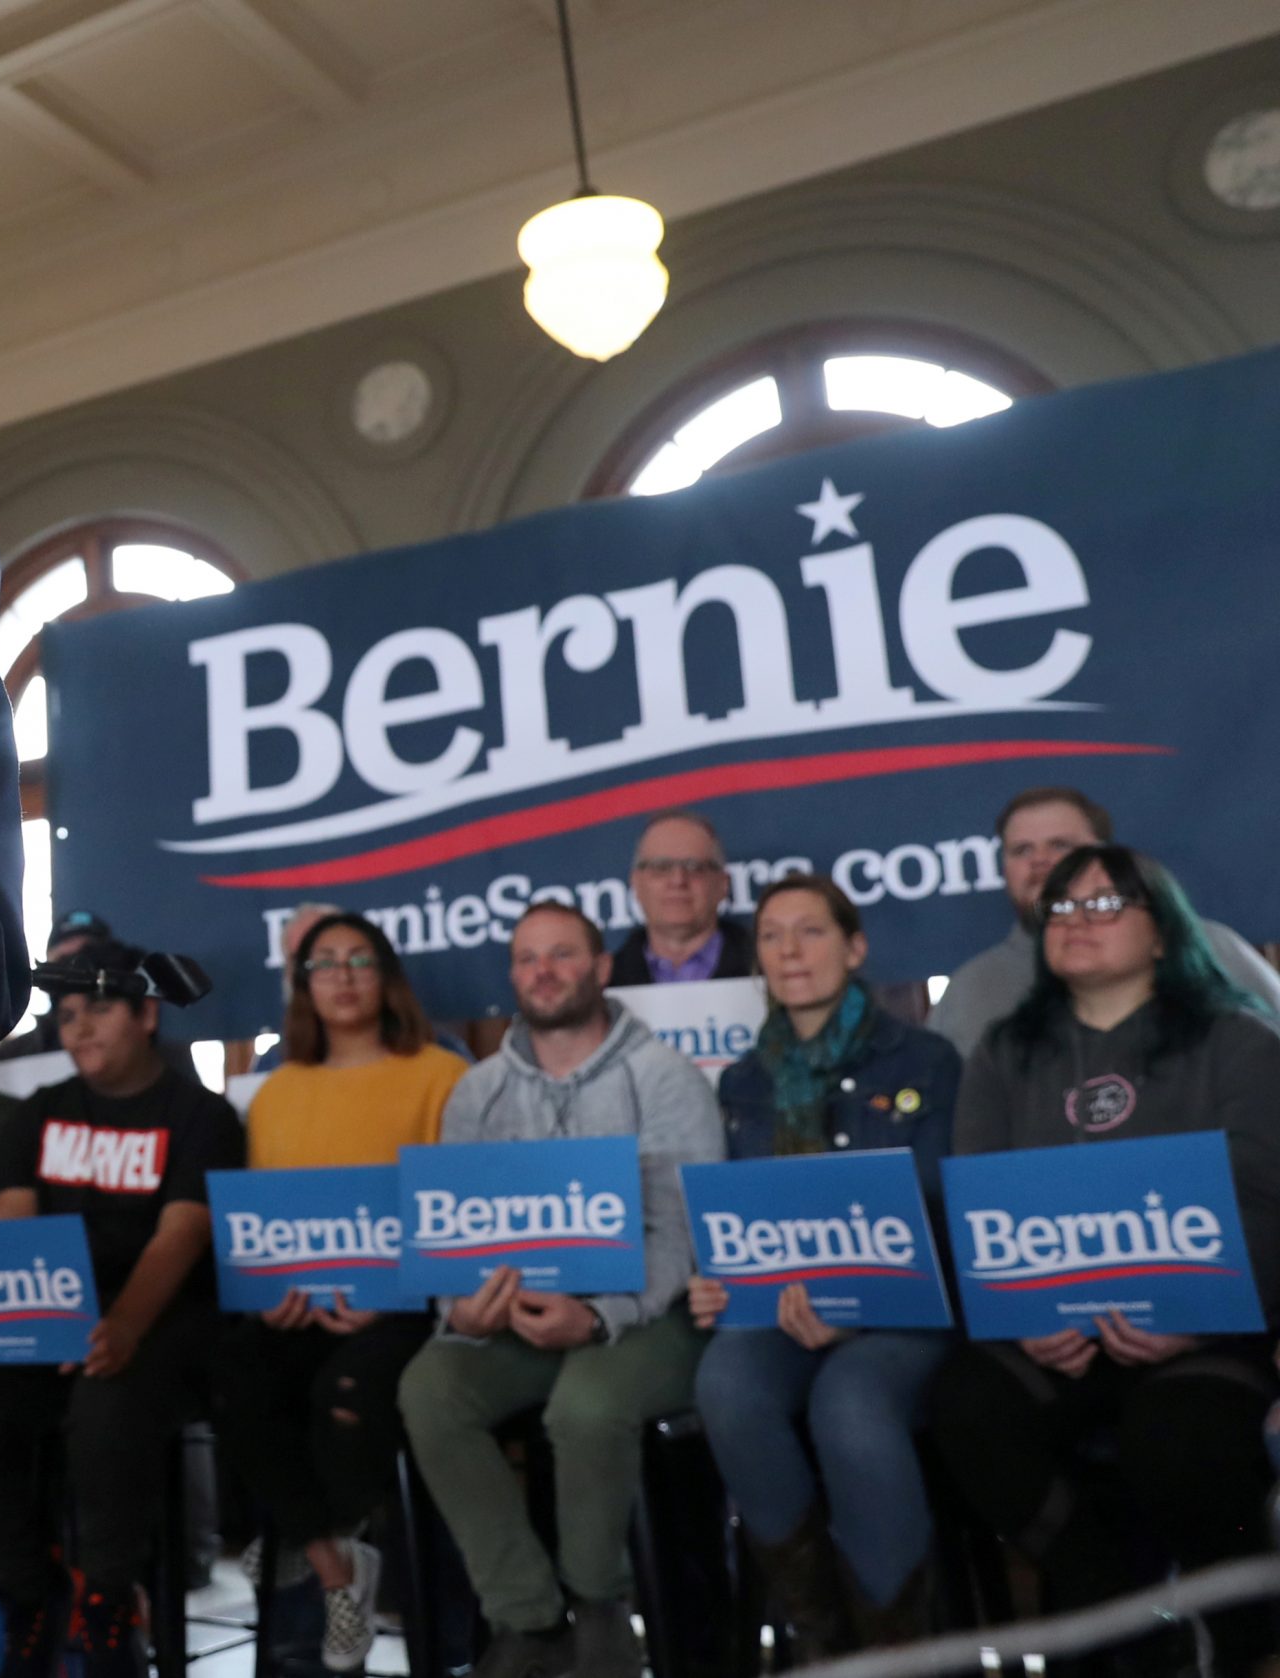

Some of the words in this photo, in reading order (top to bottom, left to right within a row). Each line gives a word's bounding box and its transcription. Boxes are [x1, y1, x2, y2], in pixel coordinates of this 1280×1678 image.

[188, 480, 1093, 825] Bernie
[656, 1016, 752, 1056] nie
[40, 1121, 164, 1190] MARVEL
[227, 1207, 403, 1260] Bernie
[414, 1180, 626, 1241] Bernie
[703, 1203, 916, 1267] Bernie
[966, 1190, 1222, 1271] Bernie
